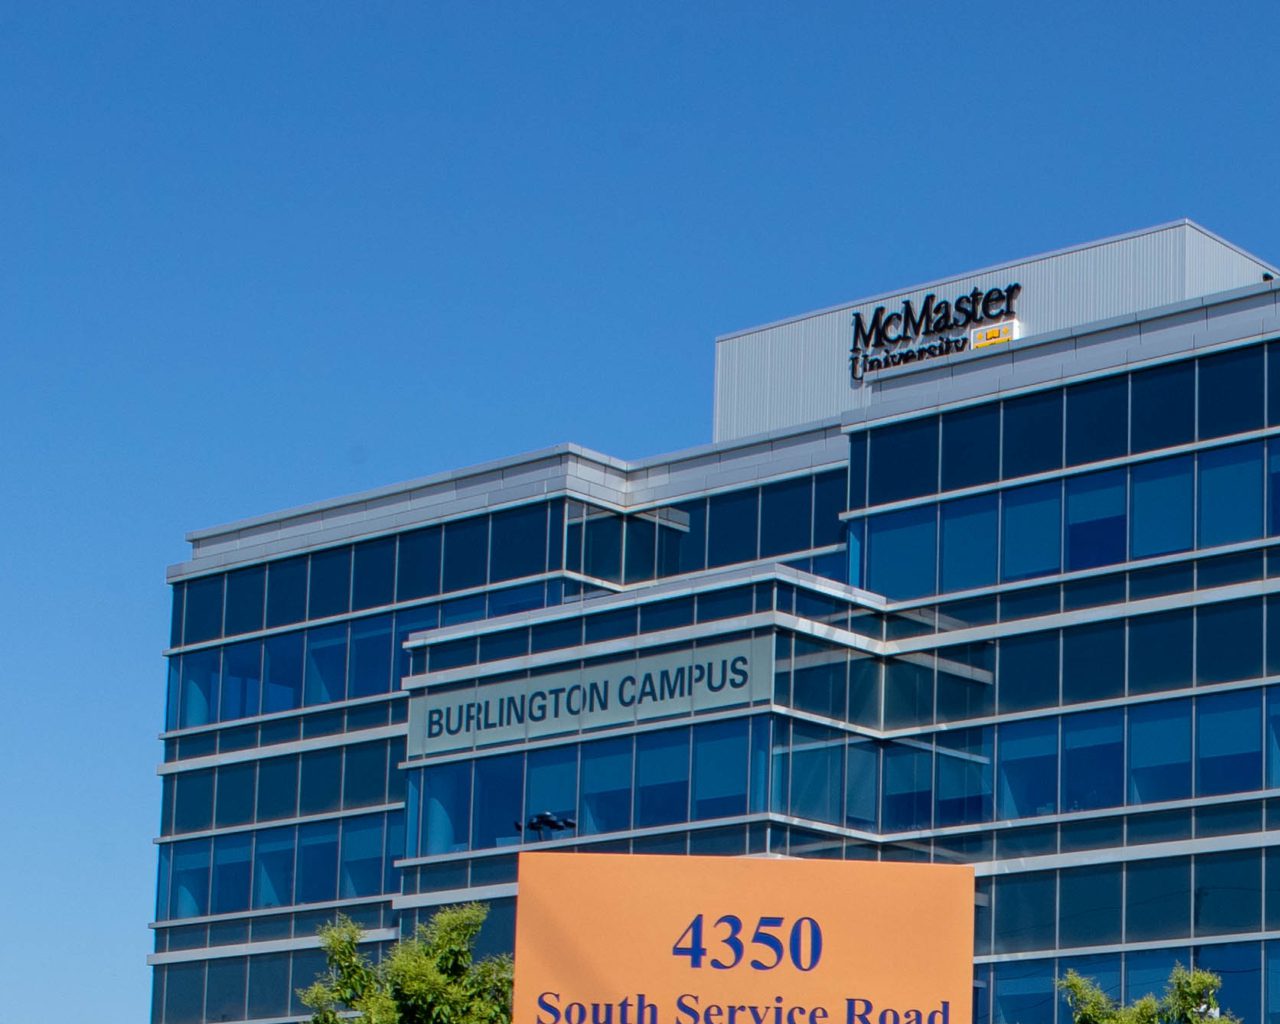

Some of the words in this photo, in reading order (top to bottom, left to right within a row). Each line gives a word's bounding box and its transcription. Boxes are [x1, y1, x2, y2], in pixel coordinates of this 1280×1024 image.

[852, 282, 1021, 352] McMaster
[849, 336, 968, 381] University
[426, 681, 609, 739] BURLINGTON
[618, 655, 749, 708] CAMPUS
[672, 914, 823, 971] 4350
